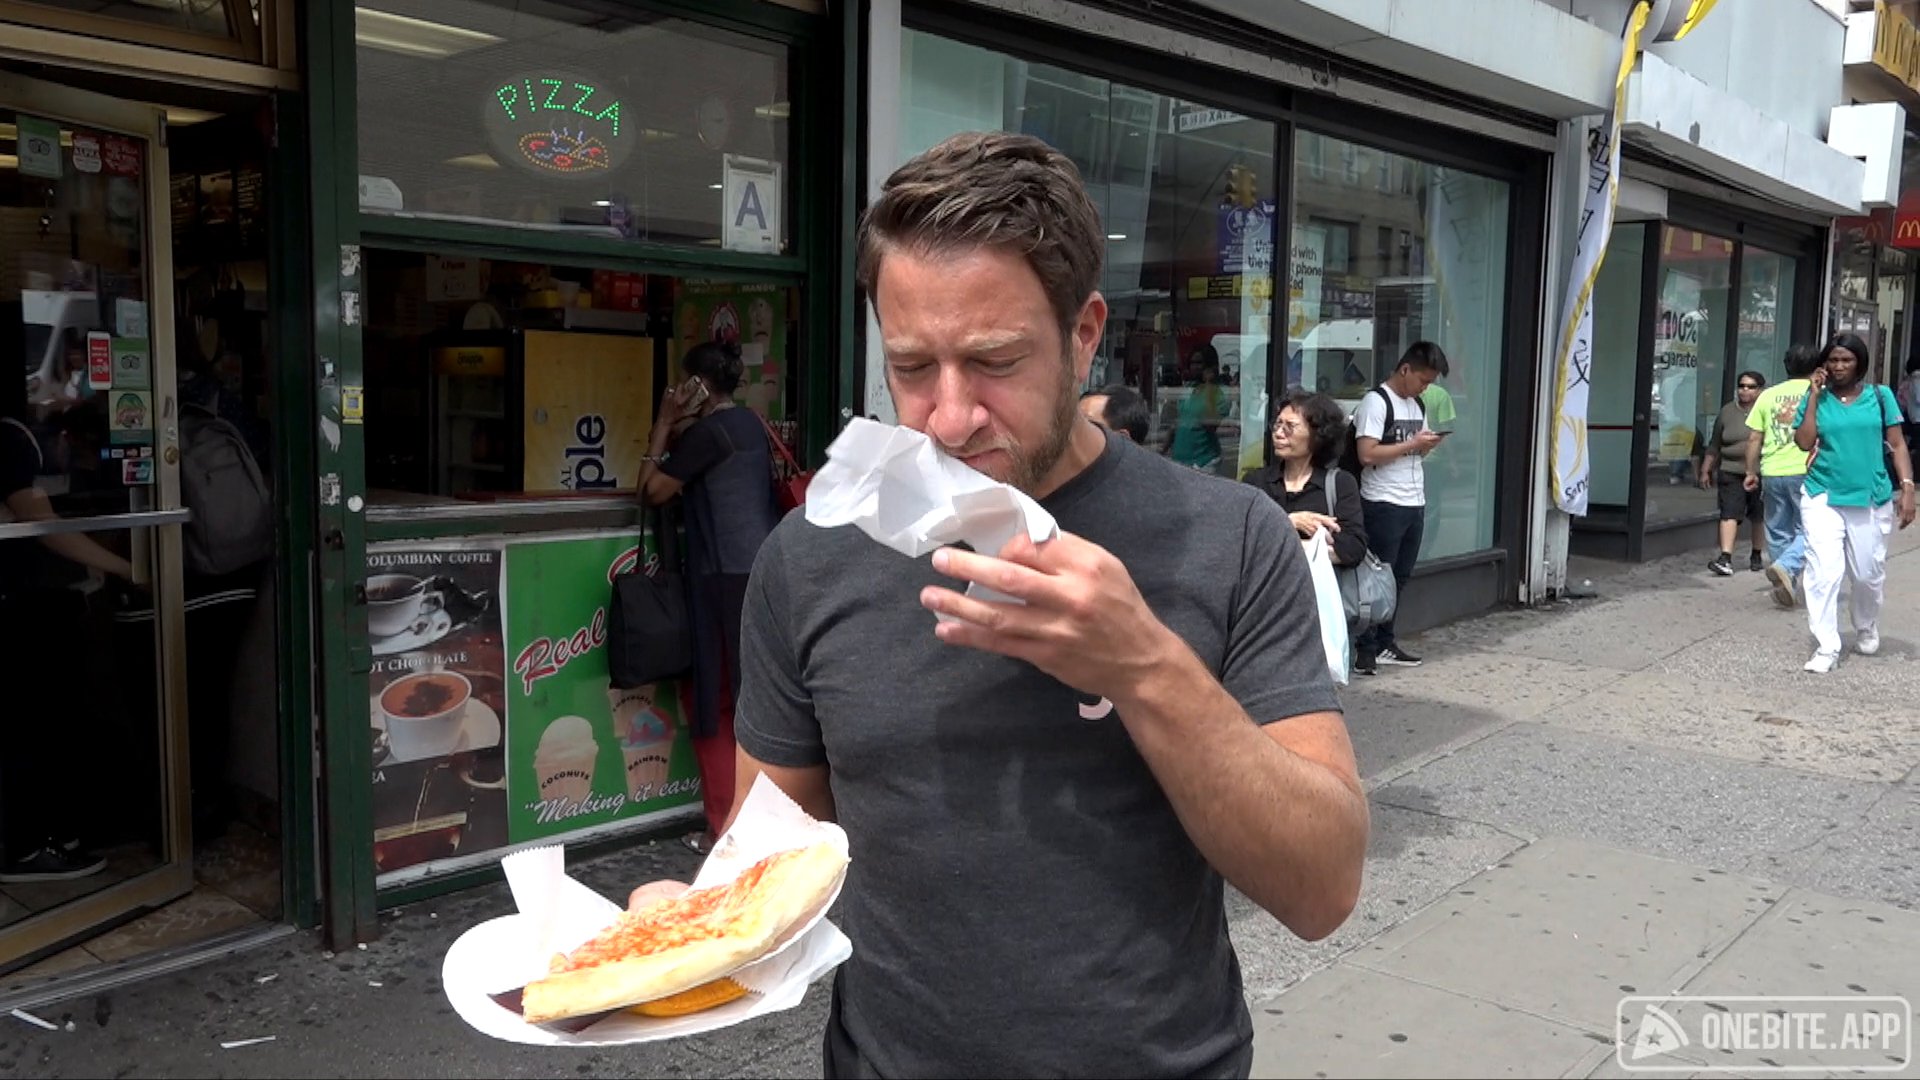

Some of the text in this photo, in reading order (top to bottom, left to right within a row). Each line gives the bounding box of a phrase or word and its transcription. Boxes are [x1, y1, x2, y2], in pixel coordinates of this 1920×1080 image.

[496, 78, 622, 136] PIZZA
[734, 181, 768, 230] A
[1298, 245, 1317, 261] with
[1296, 263, 1322, 277] phone
[741, 284, 776, 293] MANGO
[366, 553, 493, 567] OLUMBIAN COFFEE
[513, 606, 607, 697] Real
[635, 781, 653, 802] it
[658, 777, 702, 798] easy
